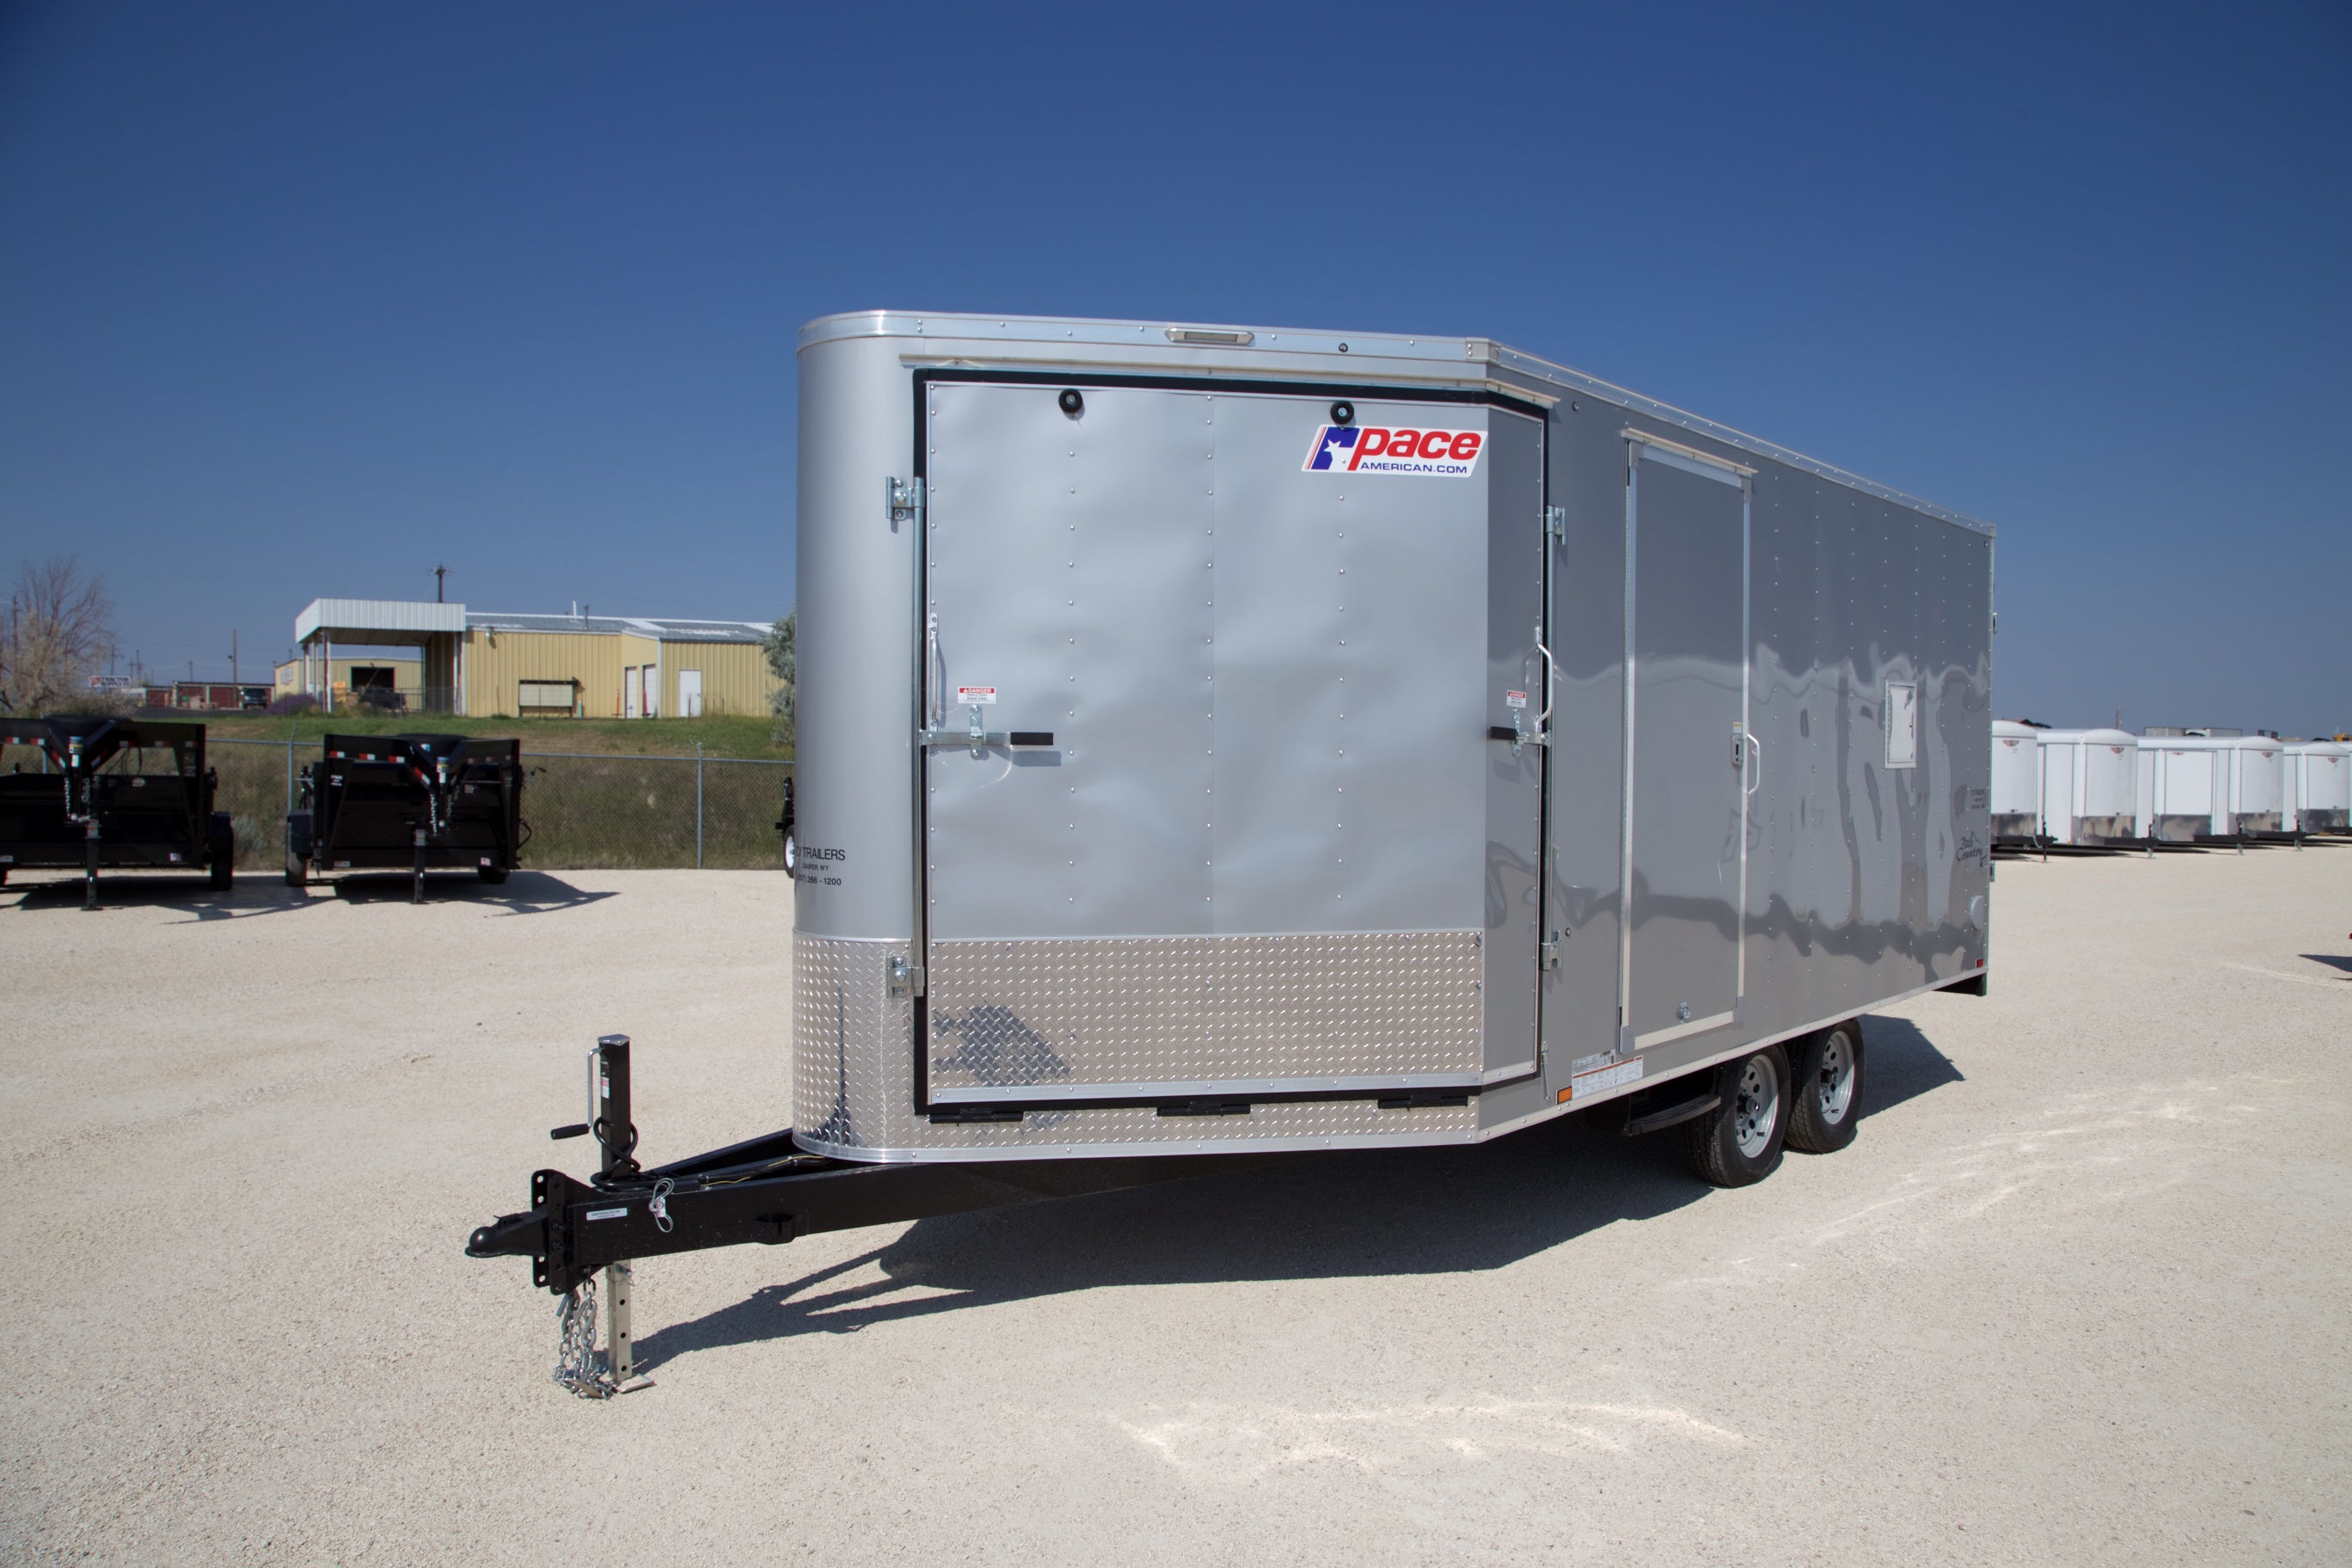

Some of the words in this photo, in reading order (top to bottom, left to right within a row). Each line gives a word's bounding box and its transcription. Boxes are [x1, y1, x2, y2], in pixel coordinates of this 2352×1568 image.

[1347, 427, 1481, 471] pace
[1360, 462, 1467, 474] AMERICAN.COM
[803, 847, 845, 861] TRAILERS
[1956, 847, 1985, 862] Country
[824, 877, 842, 886] 1200
